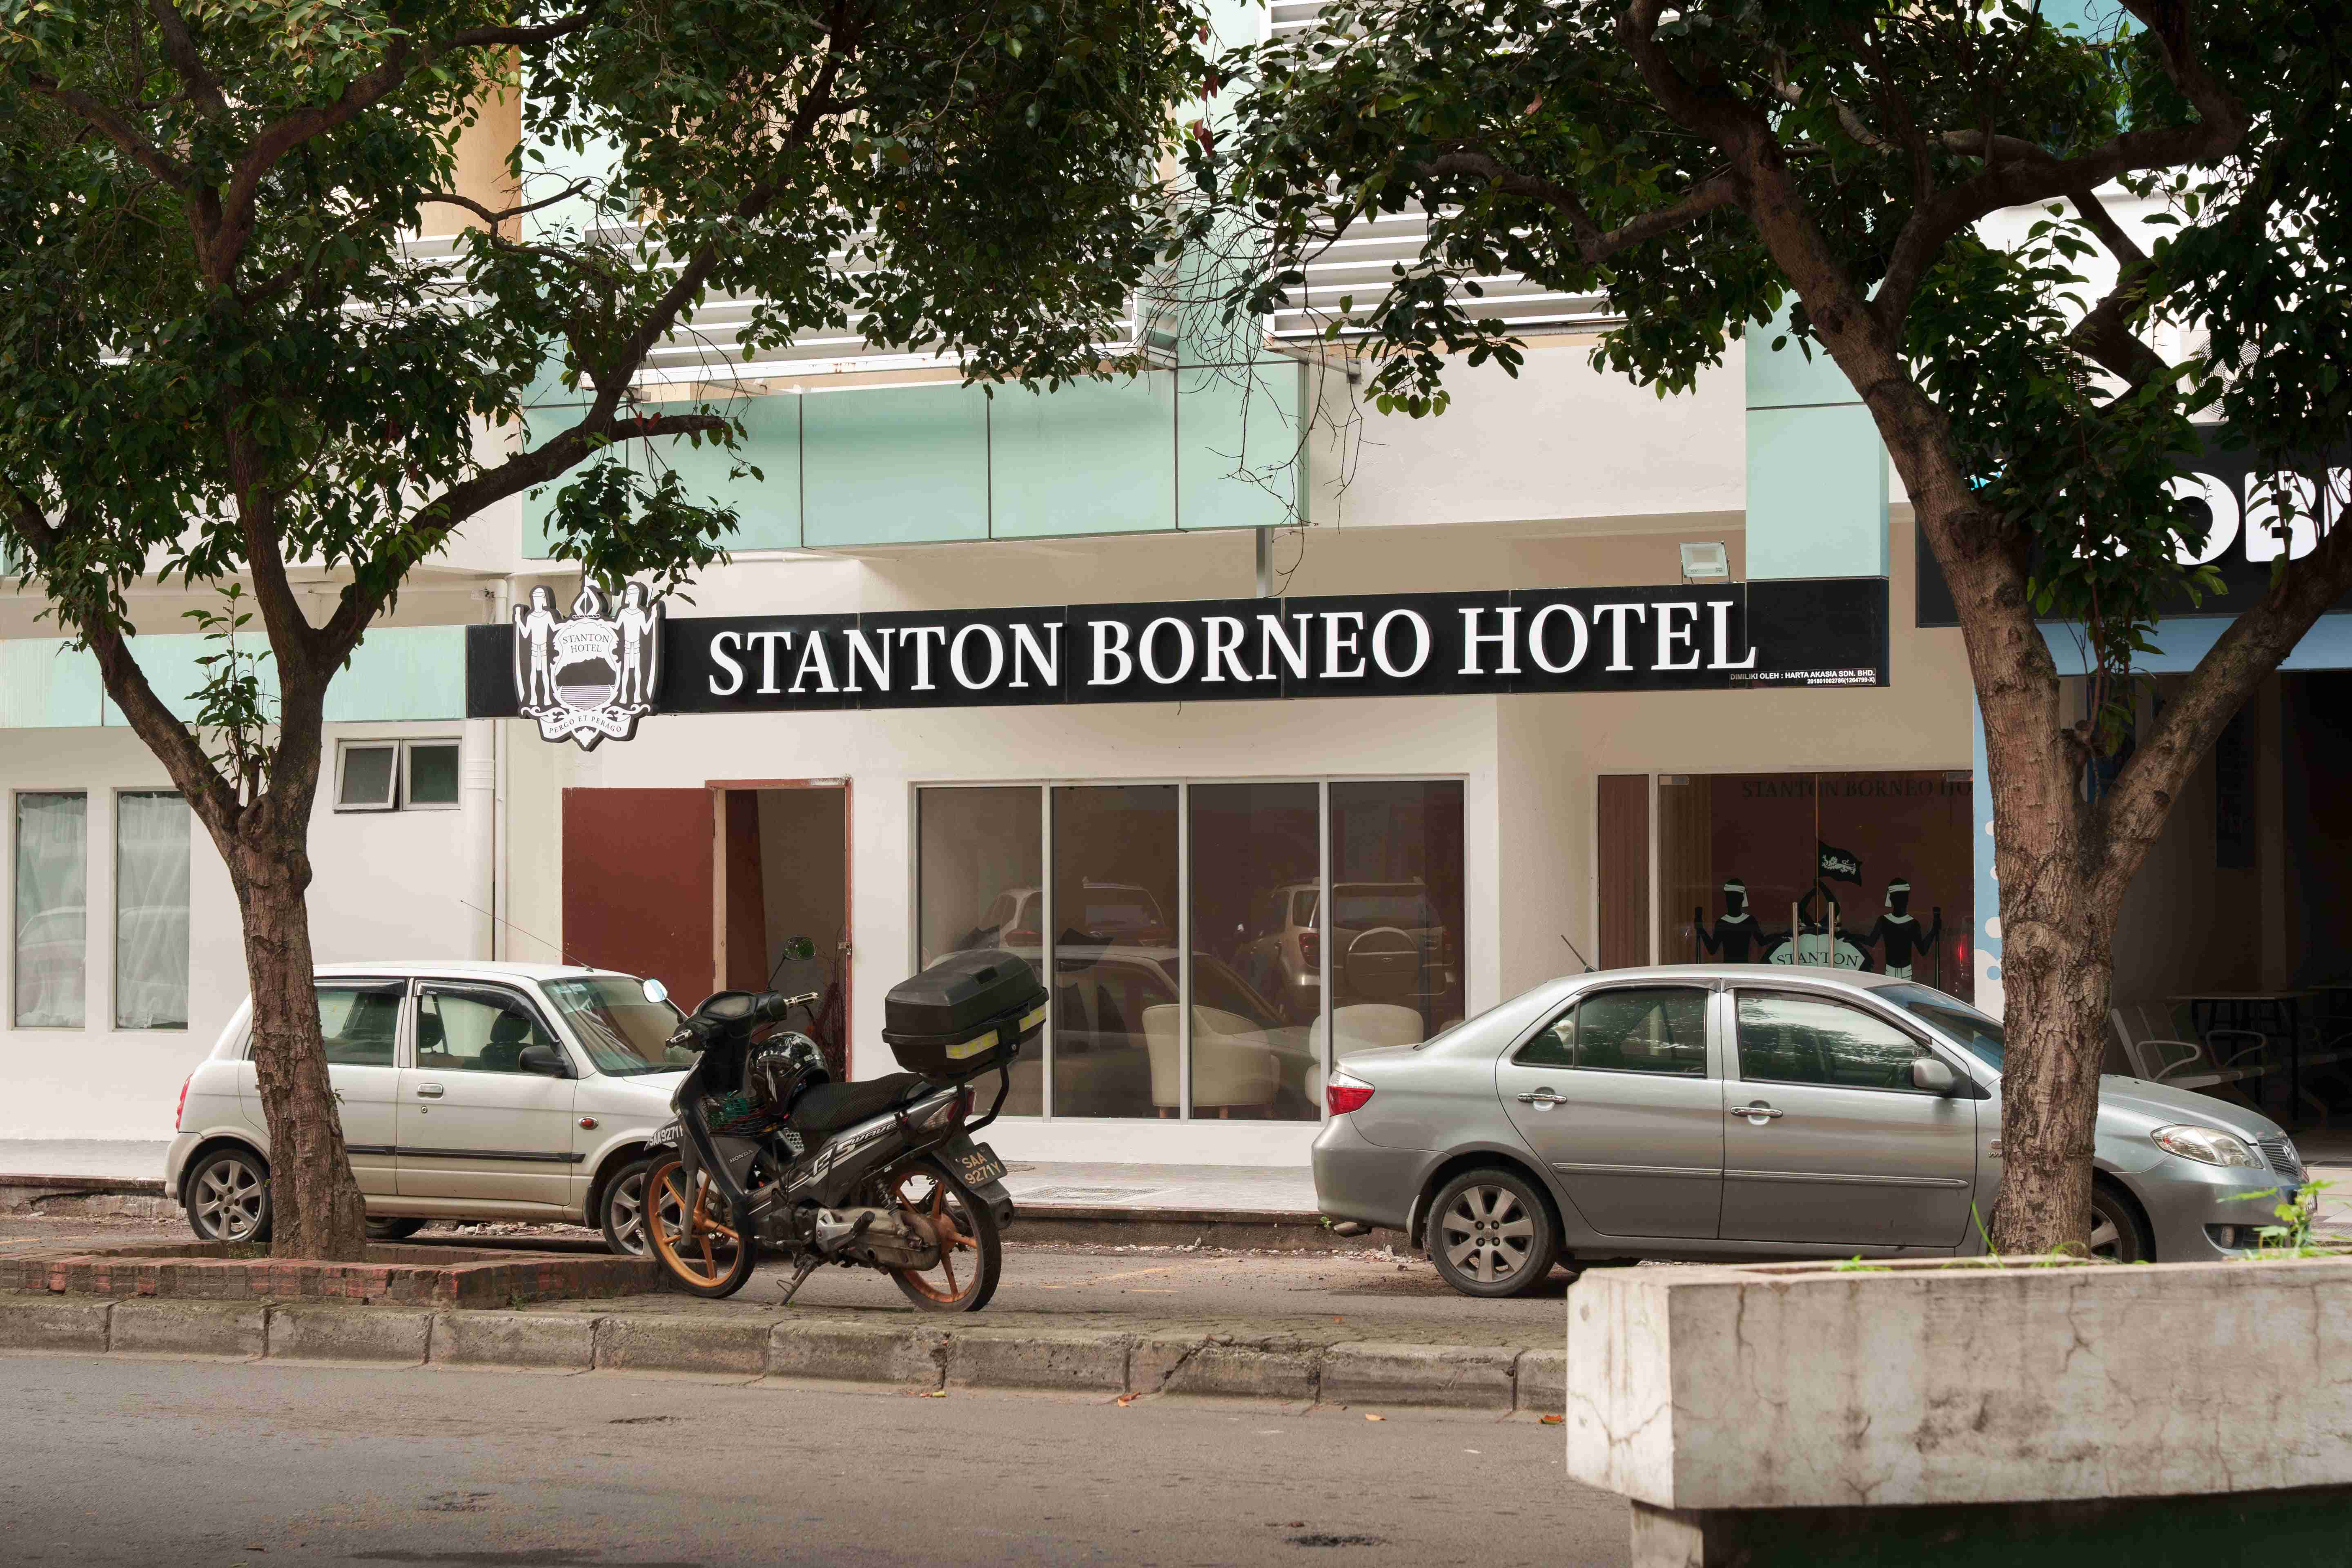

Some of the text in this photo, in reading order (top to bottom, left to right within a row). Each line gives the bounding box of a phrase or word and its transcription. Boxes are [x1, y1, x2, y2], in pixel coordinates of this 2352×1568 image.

[563, 634, 609, 644] STANTON
[571, 644, 601, 653] HOTEL
[710, 601, 1755, 695] STANTON BORNEO HOTEL
[549, 719, 575, 733] PERGO
[591, 716, 621, 732] PERAGO
[1846, 779, 1933, 797] BORNEO
[1777, 952, 1860, 967] STANTON
[728, 1150, 755, 1163] HONDA
[962, 1152, 987, 1168] SAA
[965, 1161, 1001, 1184] 9271Y
